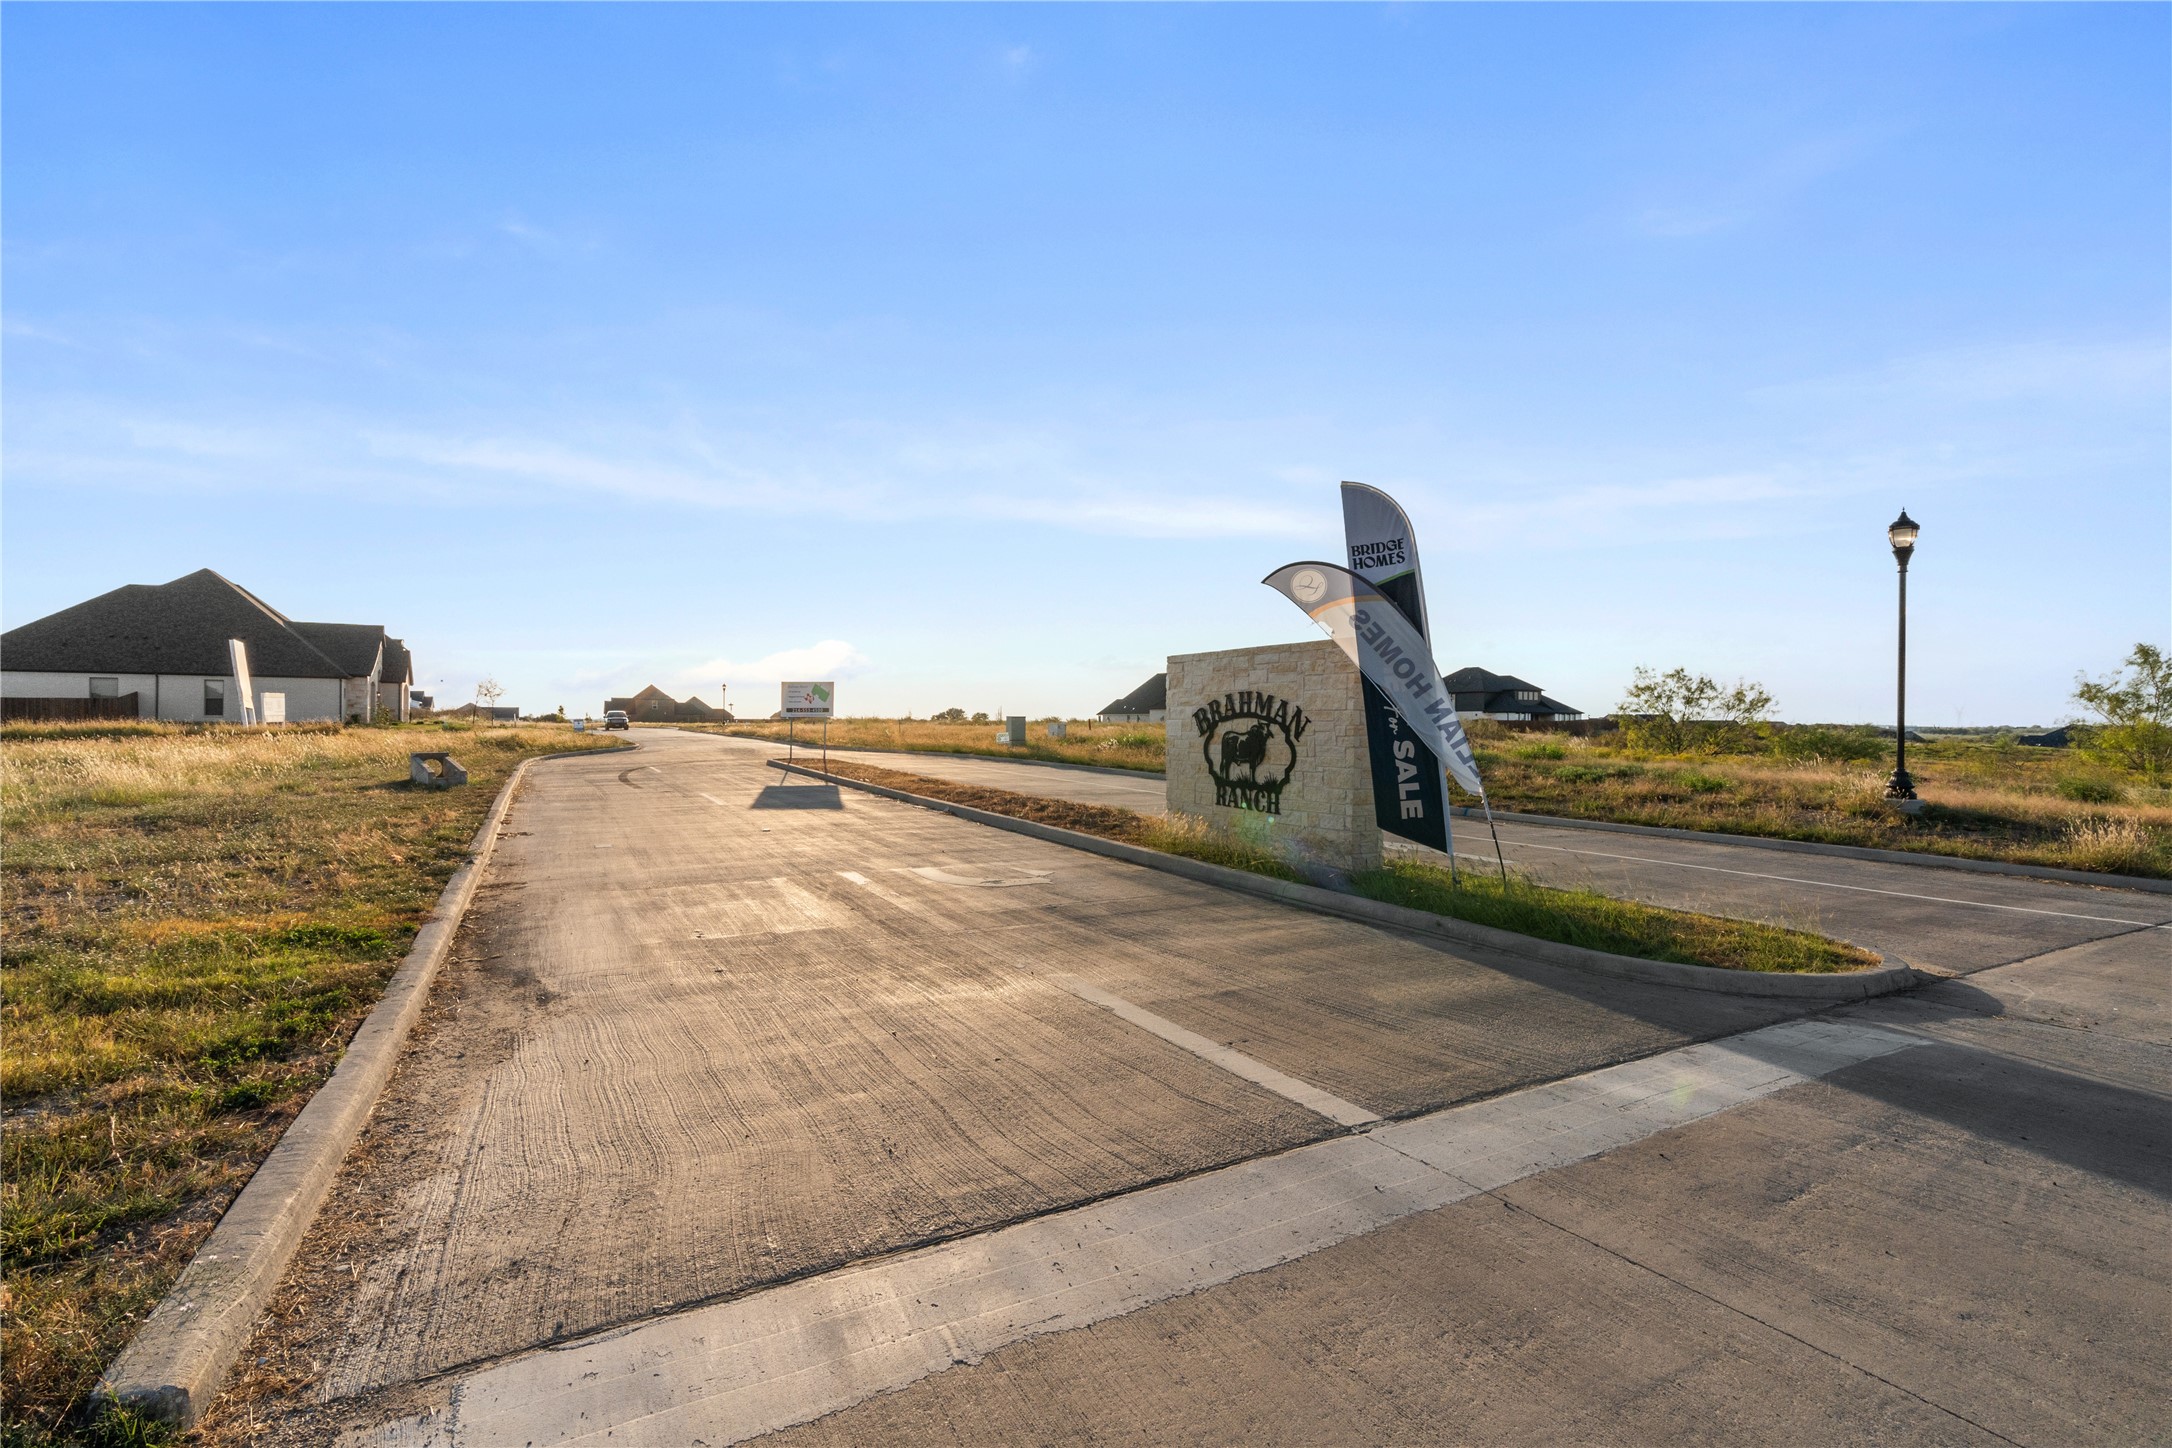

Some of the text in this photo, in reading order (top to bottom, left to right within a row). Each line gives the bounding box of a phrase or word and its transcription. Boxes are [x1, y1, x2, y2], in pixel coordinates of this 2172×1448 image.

[1351, 538, 1404, 557] BRIDGE
[1352, 551, 1406, 570] HOMES
[1192, 691, 1311, 742] BRAHMAN
[1393, 740, 1424, 820] SALE
[1215, 785, 1281, 815] RANCH
